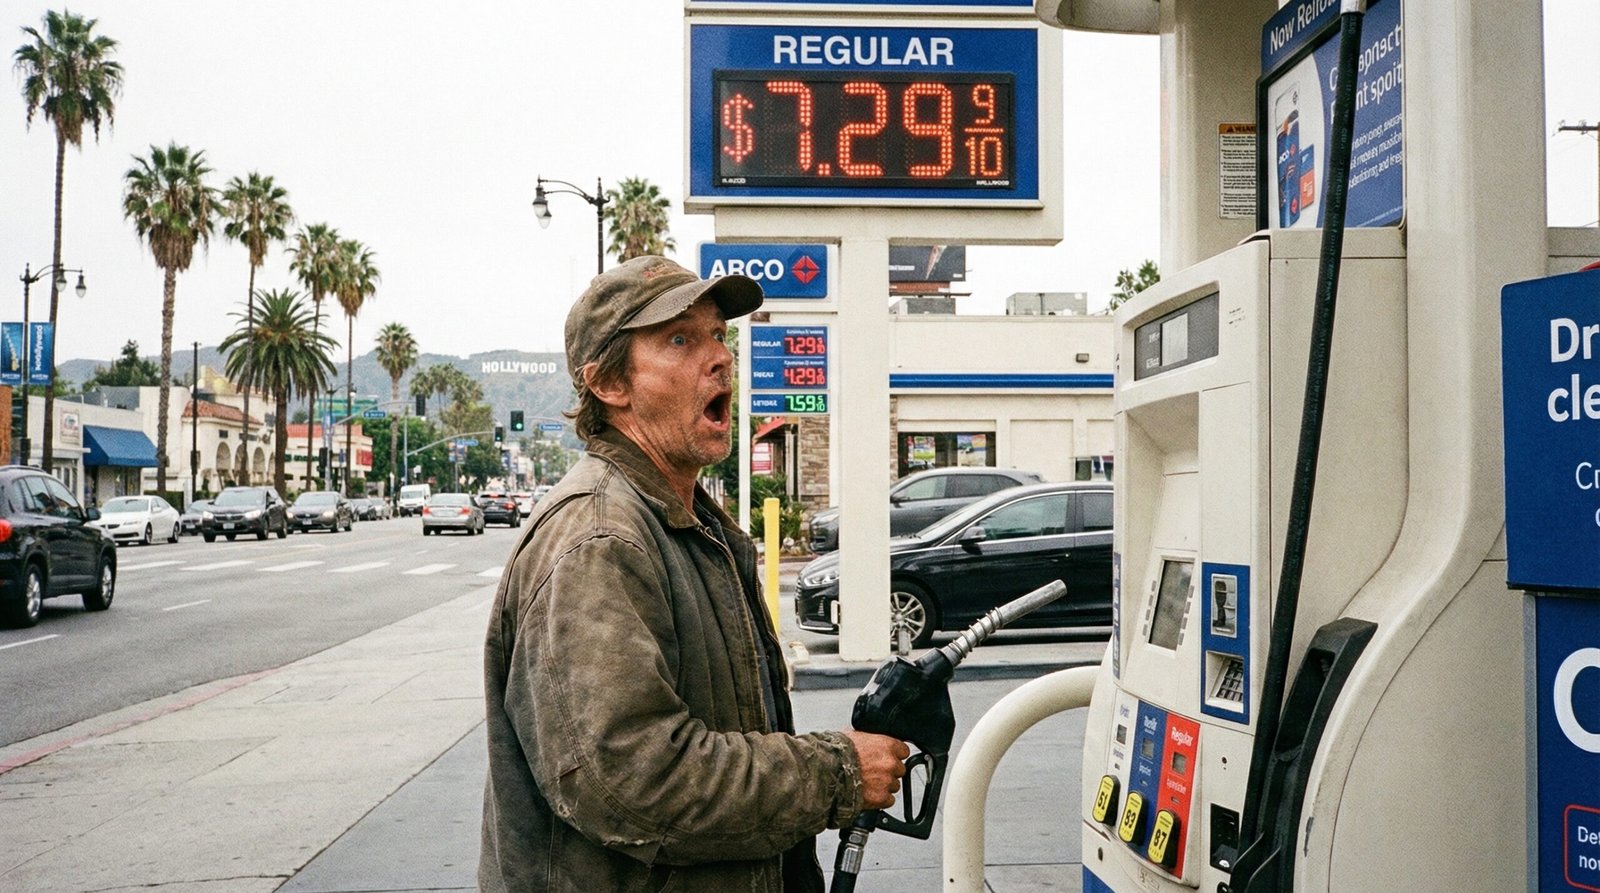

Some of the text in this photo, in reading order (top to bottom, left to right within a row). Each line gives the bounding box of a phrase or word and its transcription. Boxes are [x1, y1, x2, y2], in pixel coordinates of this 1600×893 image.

[1271, 17, 1295, 55] Now
[773, 35, 954, 66] REGULAR
[709, 259, 784, 281] ARCO
[784, 337, 816, 354] 7.29
[482, 361, 556, 373] HOLLYWOOD
[784, 368, 816, 384] 4.29
[785, 396, 816, 411] 7.59
[1153, 828, 1167, 850] 87
